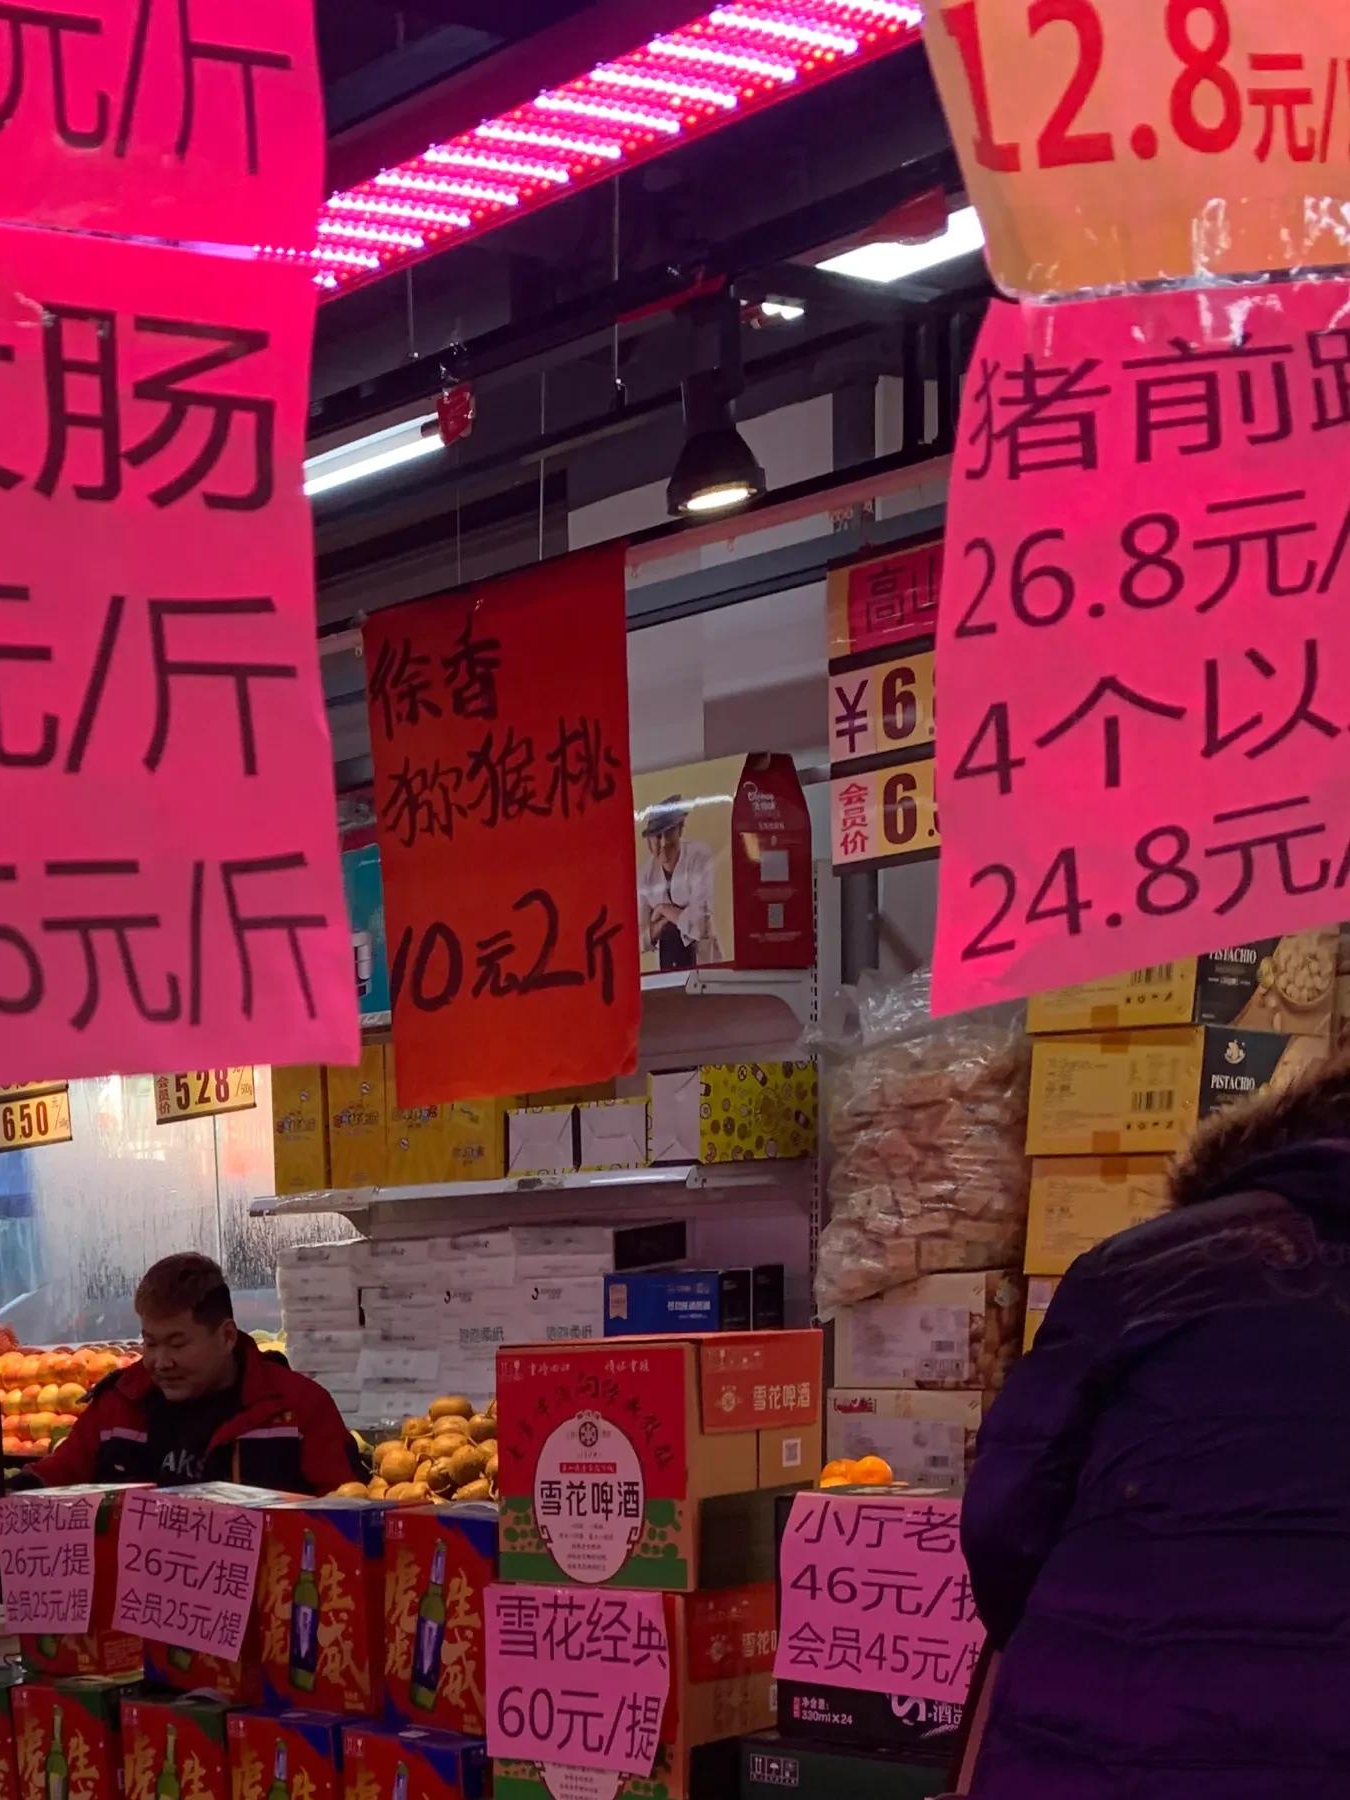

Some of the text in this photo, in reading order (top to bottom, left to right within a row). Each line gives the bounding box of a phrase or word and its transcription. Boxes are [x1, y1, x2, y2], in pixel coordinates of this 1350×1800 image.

[943, 0, 1350, 172] 12.8元/
[369, 612, 502, 740] 徐香
[840, 783, 868, 856] 会员价
[882, 772, 940, 845] 6.
[390, 888, 625, 1013] 10元2斤
[175, 1067, 230, 1110] 5.28
[2, 1100, 49, 1142] 6.50
[752, 1381, 811, 1412] 雪花啤酒
[128, 1496, 258, 1552] 干啤礼盒
[540, 1480, 639, 1522] 雪花啤酒
[1, 1543, 91, 1578] 26元/提
[124, 1544, 251, 1601] 26元/提
[6, 1588, 89, 1623] 会员25元/提
[120, 1587, 243, 1649] 会员25元/提
[496, 1595, 667, 1670] 雪花经典
[497, 1685, 662, 1762] 60元/提
